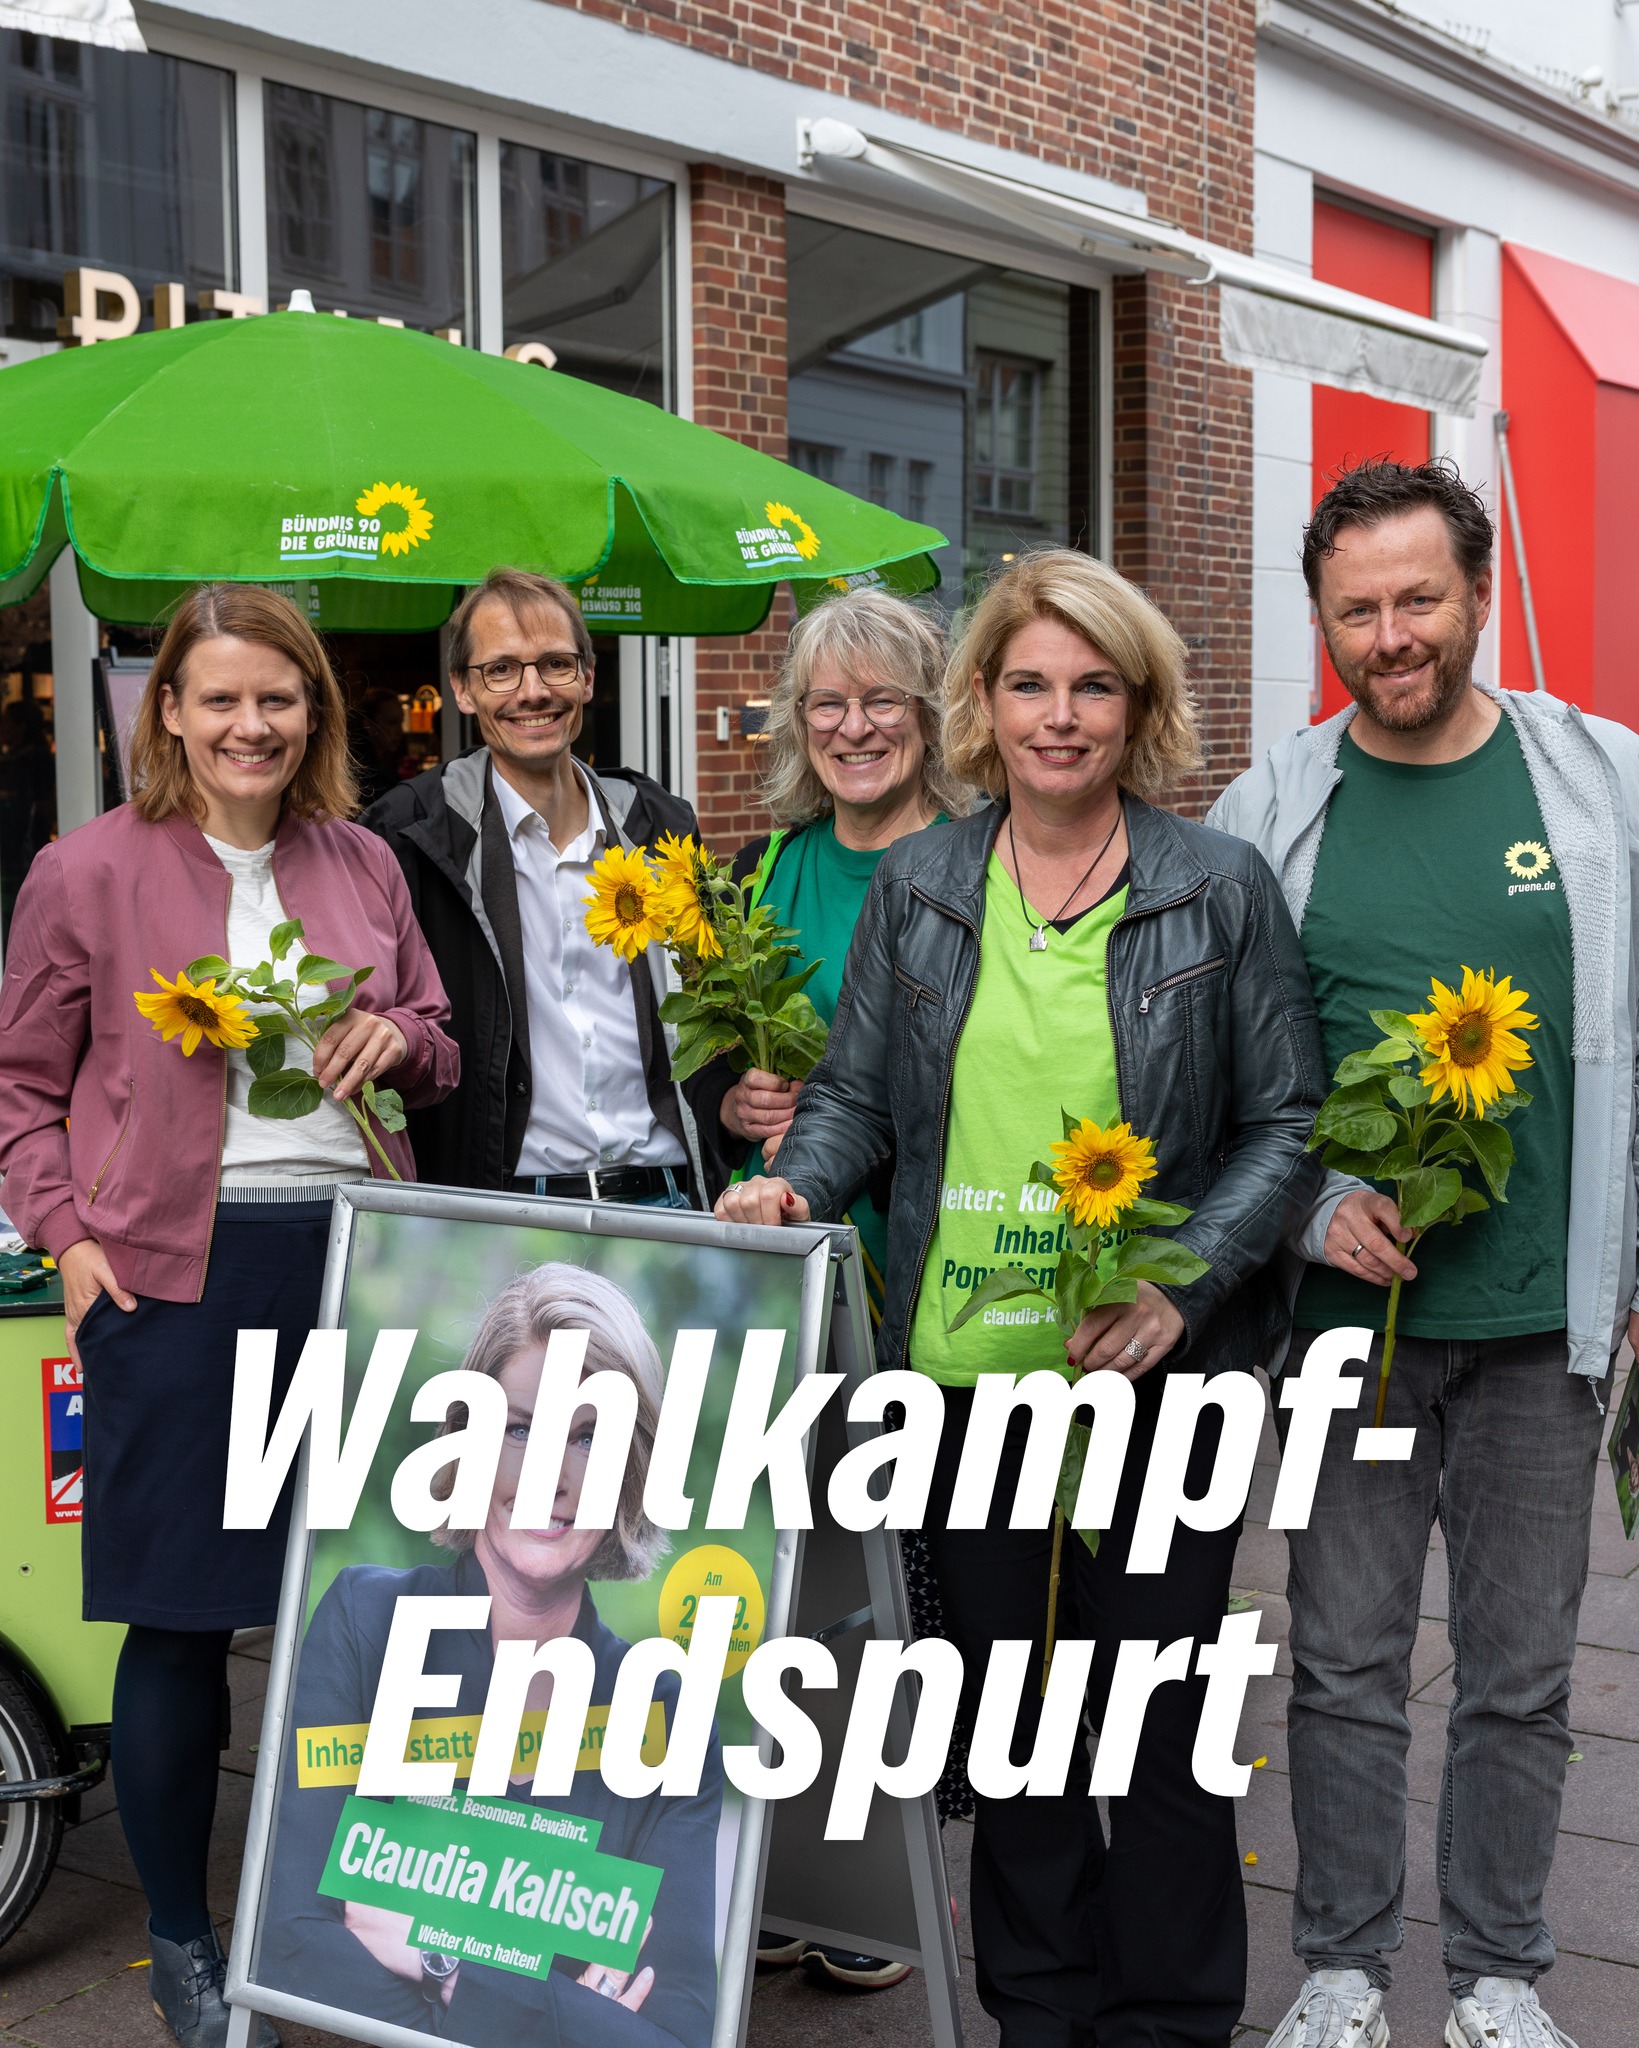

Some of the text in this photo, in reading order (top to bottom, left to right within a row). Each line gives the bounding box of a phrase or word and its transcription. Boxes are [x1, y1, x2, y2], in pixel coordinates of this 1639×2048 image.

[282, 514, 381, 533] BÜNDNIS 90
[280, 530, 379, 551] DIE GRÜNEN
[736, 528, 791, 544] BÜNDNIS 90
[741, 540, 800, 560] DIE GRÜNEN
[1508, 881, 1556, 896] gruene.de
[983, 1307, 1059, 1325] claudia-k
[704, 1571, 722, 1586] Am
[410, 1731, 475, 1762] statt
[461, 1797, 528, 1828] Besonnen.
[530, 1812, 589, 1843] Bewährt.
[338, 1822, 640, 1944] Claudia Kalisch
[417, 1924, 542, 1972] Weiter Kurs halten!
